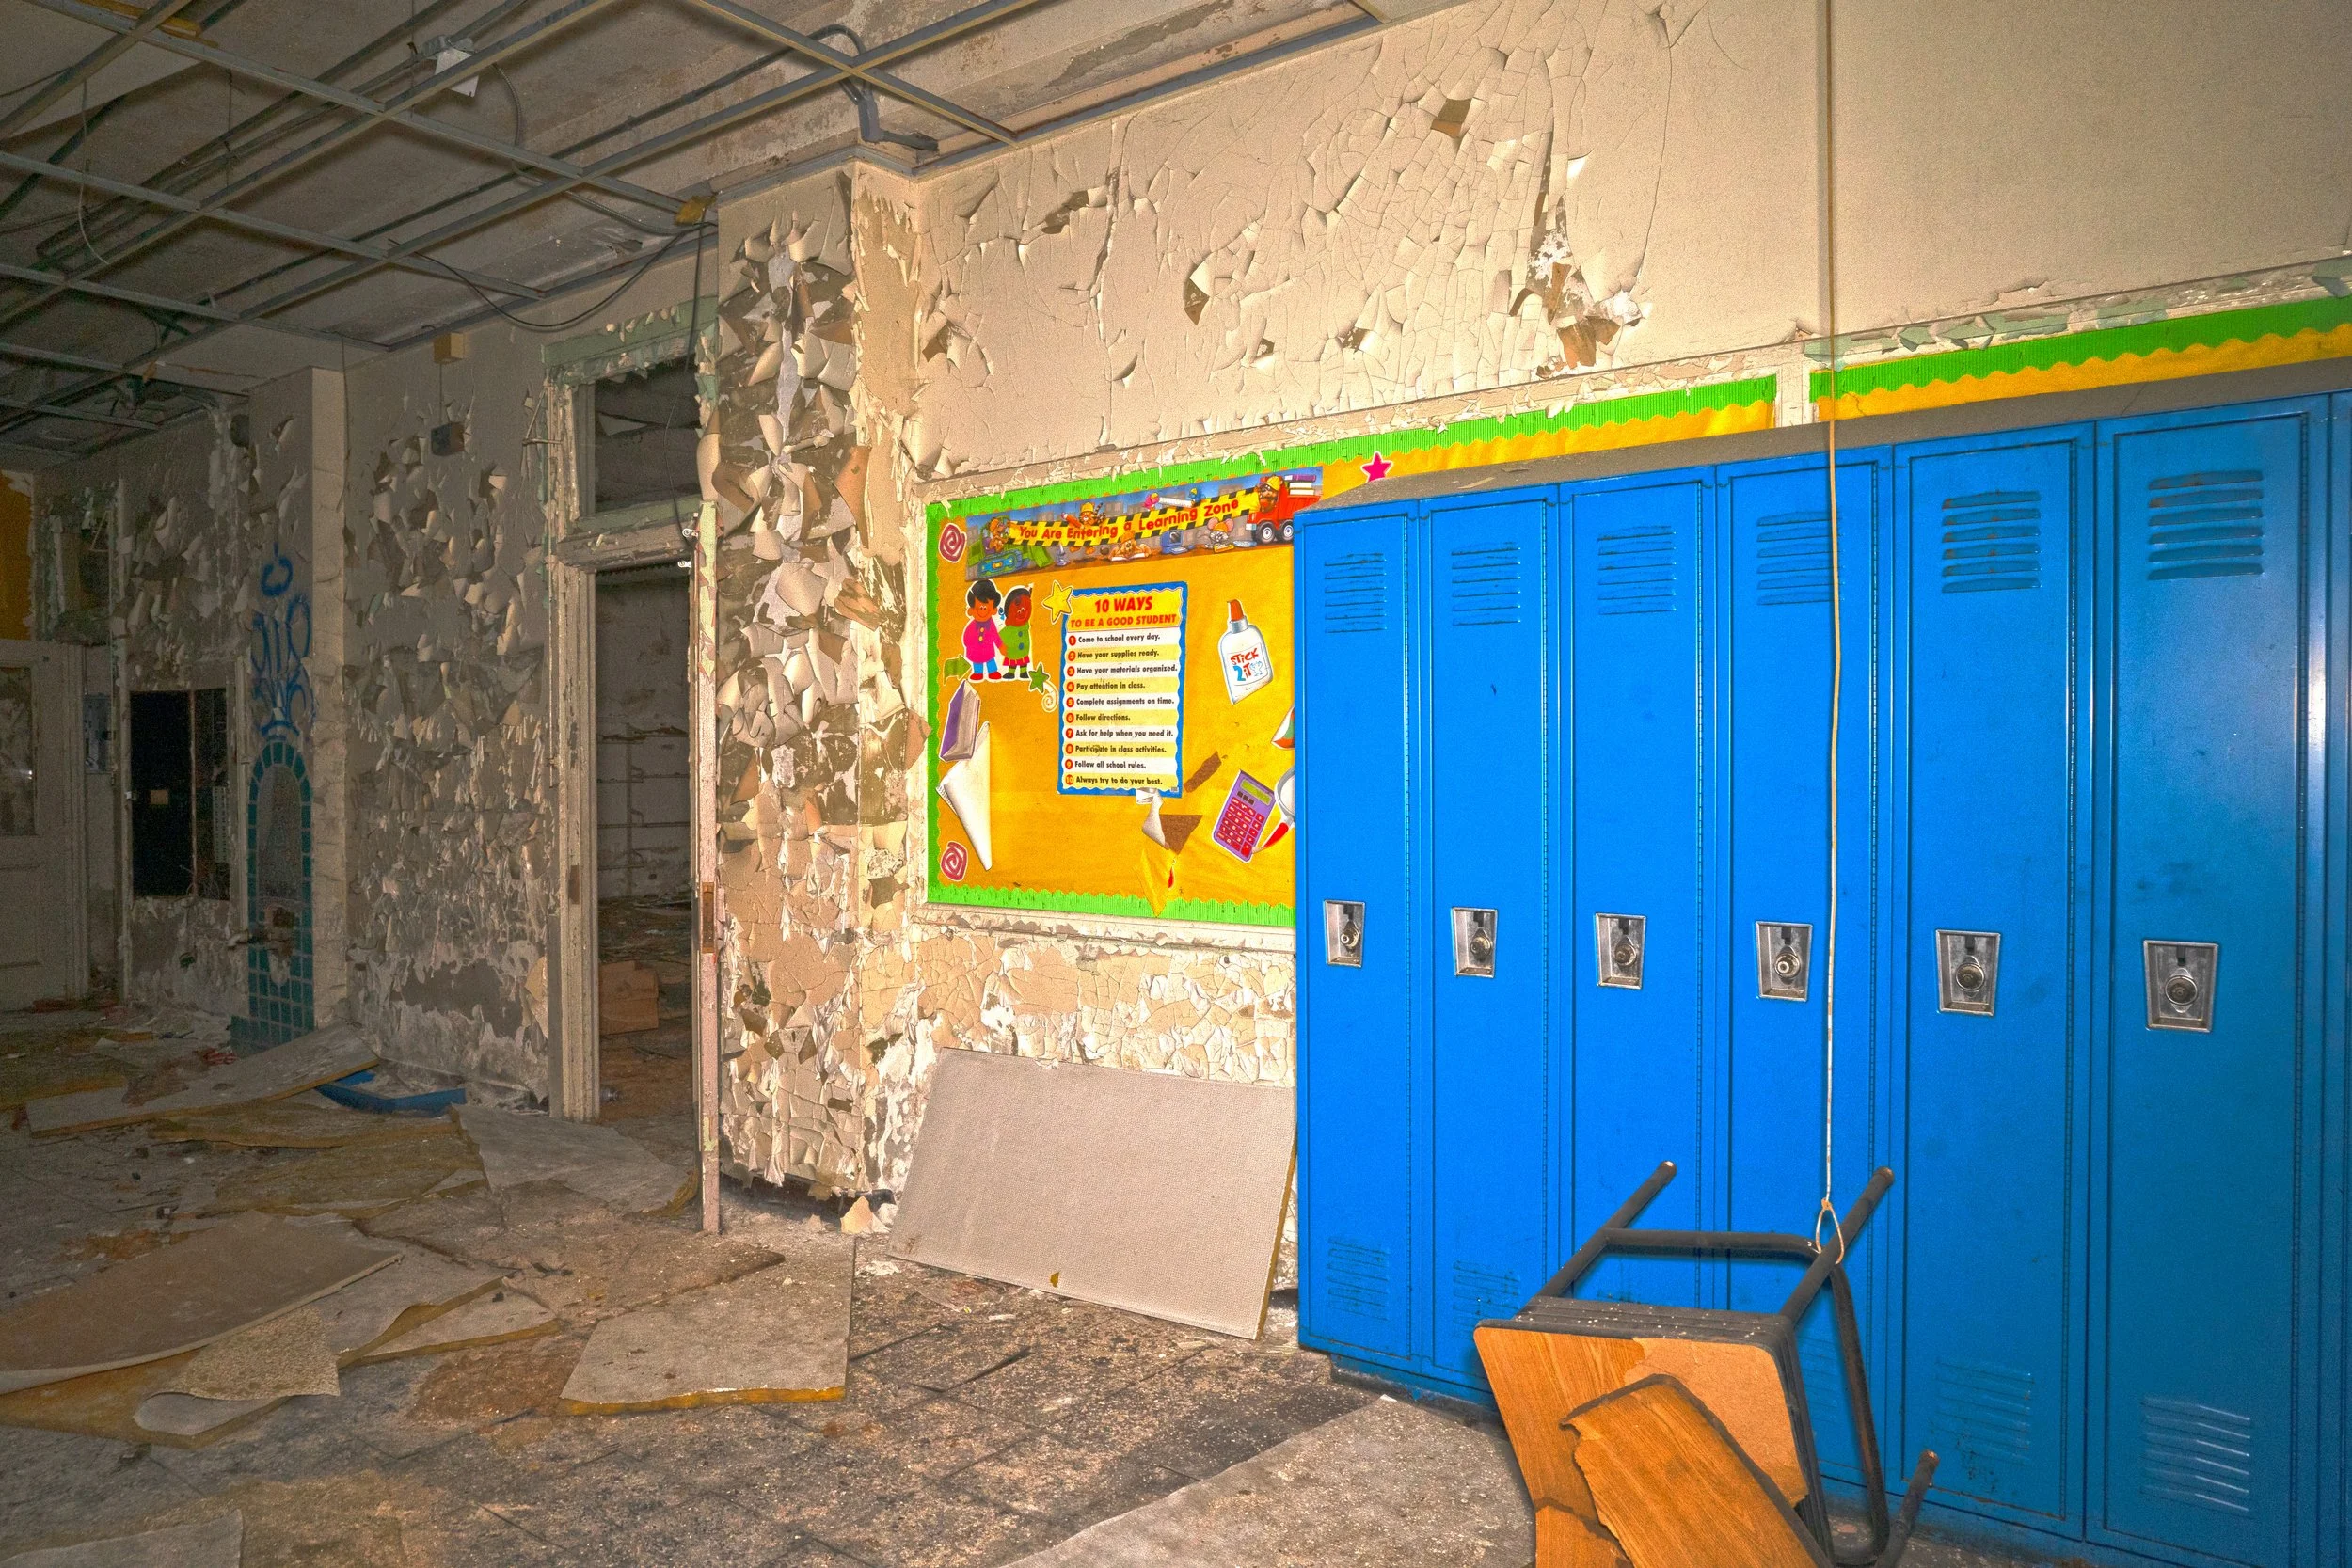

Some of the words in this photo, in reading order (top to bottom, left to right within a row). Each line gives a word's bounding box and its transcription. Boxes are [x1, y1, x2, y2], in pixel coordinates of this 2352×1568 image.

[1019, 526, 1038, 538] You
[1042, 528, 1062, 539] Are
[1067, 526, 1118, 540] Entering
[1124, 521, 1131, 531] a
[1139, 508, 1197, 530] Learning
[1204, 499, 1238, 517] Zone
[1095, 599, 1110, 613] 10
[1113, 596, 1153, 612] WAYS
[1070, 618, 1082, 628] TO
[1084, 618, 1095, 627] BE
[1097, 618, 1104, 627] A
[1106, 616, 1134, 626] GOOD
[1136, 614, 1177, 625] STUDENT
[1105, 634, 1124, 642] school
[1146, 632, 1160, 641] day.
[1110, 649, 1137, 659] supplies
[1138, 648, 1160, 658] ready.
[1110, 665, 1141, 673] materials
[1142, 664, 1178, 674] organized.
[1233, 665, 1246, 681] 2
[1076, 683, 1088, 691] Pay
[1127, 681, 1146, 689] class.
[1076, 697, 1105, 707] Complete
[1106, 697, 1145, 707] assignments
[1099, 729, 1114, 738] help
[1075, 744, 1109, 754] Participate
[1127, 761, 1146, 769] rules.
[1076, 775, 1098, 785] Always
[1099, 777, 1110, 785] try
